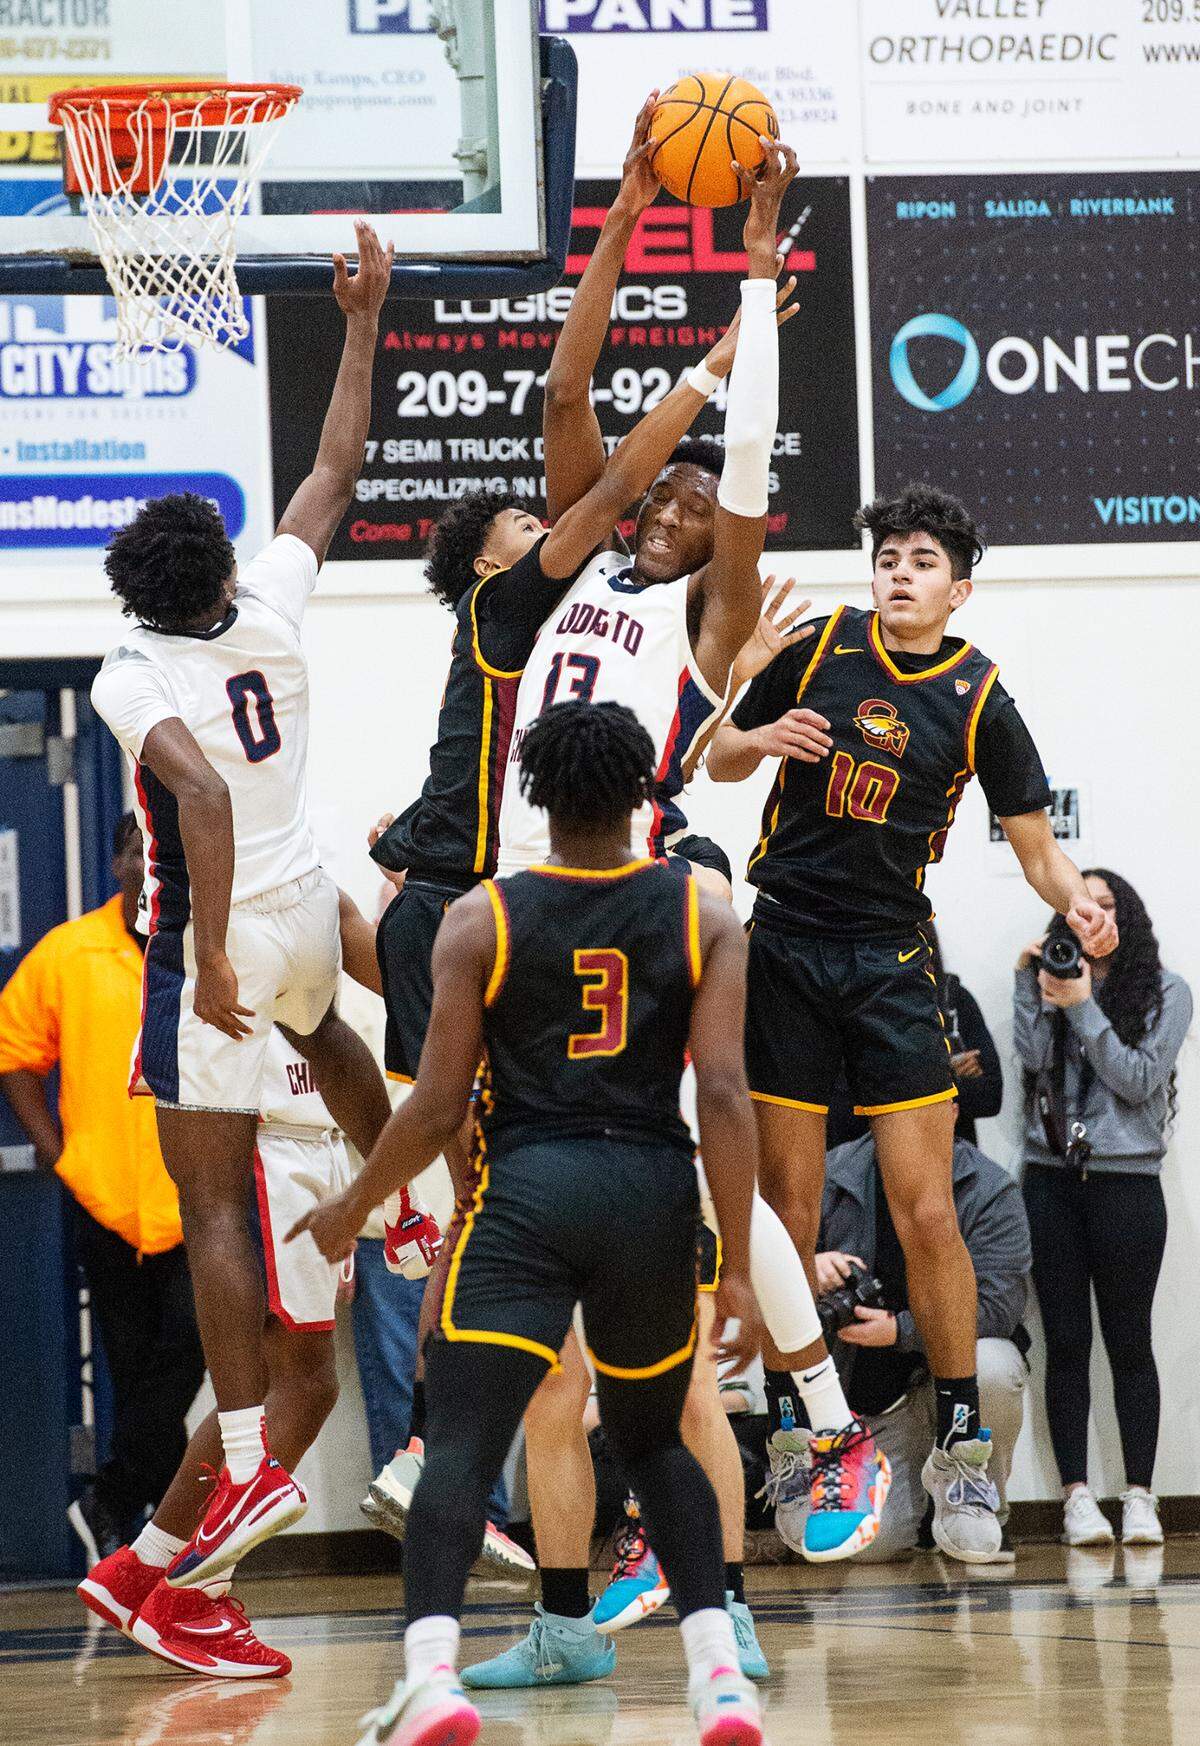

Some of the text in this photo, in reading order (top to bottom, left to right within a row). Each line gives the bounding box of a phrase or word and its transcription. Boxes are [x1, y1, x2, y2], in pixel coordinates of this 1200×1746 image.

[936, 0, 1046, 18] VALLEY
[869, 34, 1118, 63] ORTHOPAEDIC
[907, 97, 1083, 117] BONE AND JOINT
[896, 201, 956, 218] RIPON
[985, 200, 1051, 218] SALIDA
[1069, 197, 1175, 216] RIVERBANK
[384, 330, 486, 352] Always
[2, 343, 85, 396] CITY
[383, 439, 442, 463] SEMI
[446, 437, 531, 462] TRUCK
[225, 669, 281, 764] 0
[825, 750, 900, 824] 10
[567, 947, 629, 1059] 3
